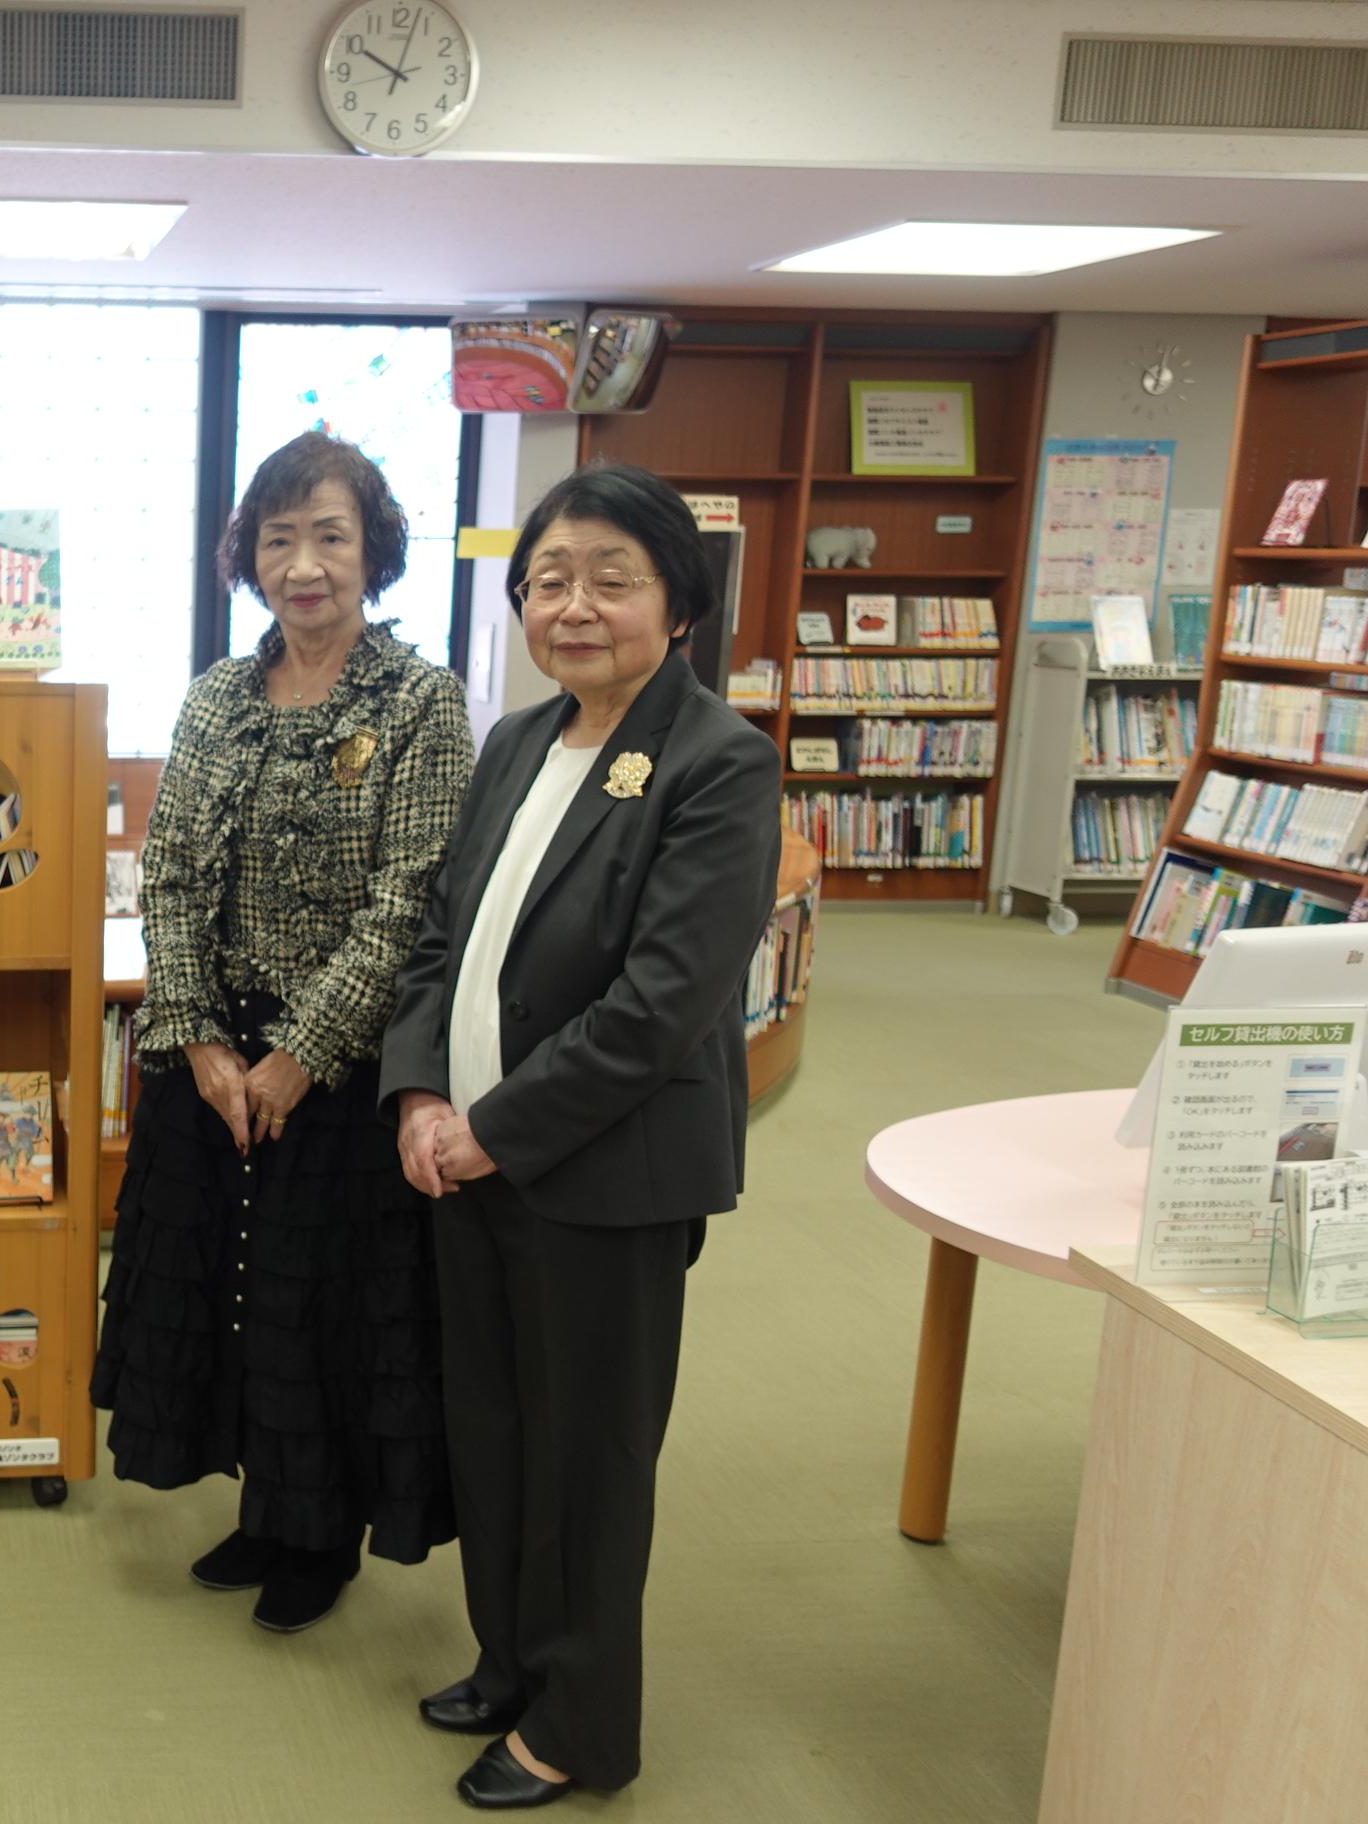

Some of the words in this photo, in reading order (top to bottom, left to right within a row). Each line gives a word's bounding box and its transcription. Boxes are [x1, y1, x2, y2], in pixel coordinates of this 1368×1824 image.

[367, 14, 382, 35] 11
[392, 7, 410, 29] 12
[423, 16, 429, 36] 1
[346, 34, 364, 55] 10
[438, 37, 453, 57] 2
[336, 62, 351, 83] 9
[444, 65, 458, 86] 3
[343, 91, 357, 111] 8
[435, 94, 448, 112] 4
[365, 112, 378, 132] 7
[387, 120, 402, 140] 6
[414, 113, 428, 134] 5
[1189, 1025, 1345, 1043] セルフ貸出機の使い方
